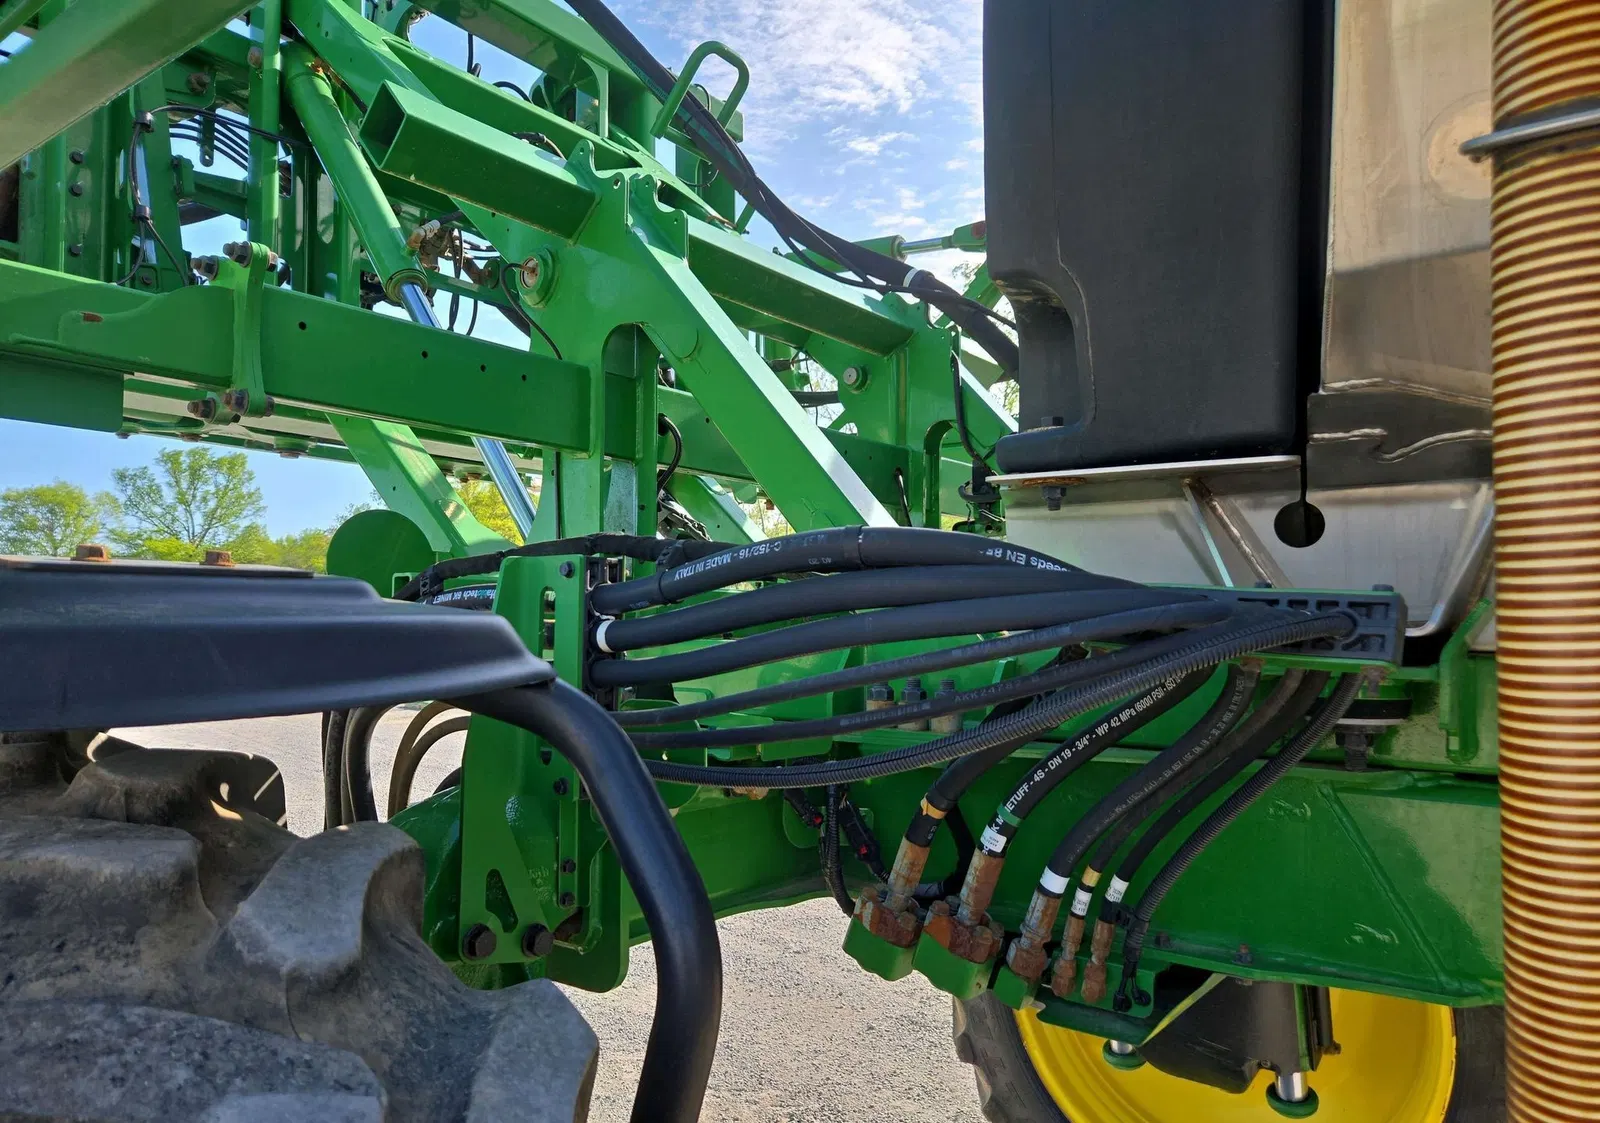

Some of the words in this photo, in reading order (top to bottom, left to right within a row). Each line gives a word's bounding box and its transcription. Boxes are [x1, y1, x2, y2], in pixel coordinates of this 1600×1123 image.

[705, 552, 732, 570] MADE
[1006, 549, 1026, 565] EN
[674, 565, 696, 581] ITALY
[695, 562, 705, 572] IN
[1033, 769, 1046, 782] 4S
[1047, 755, 1062, 770] DN
[1061, 748, 1072, 761] 19
[1095, 722, 1109, 737] WP
[1110, 716, 1121, 728] 42
[1119, 708, 1137, 723] MPa
[1134, 695, 1154, 713] (6000
